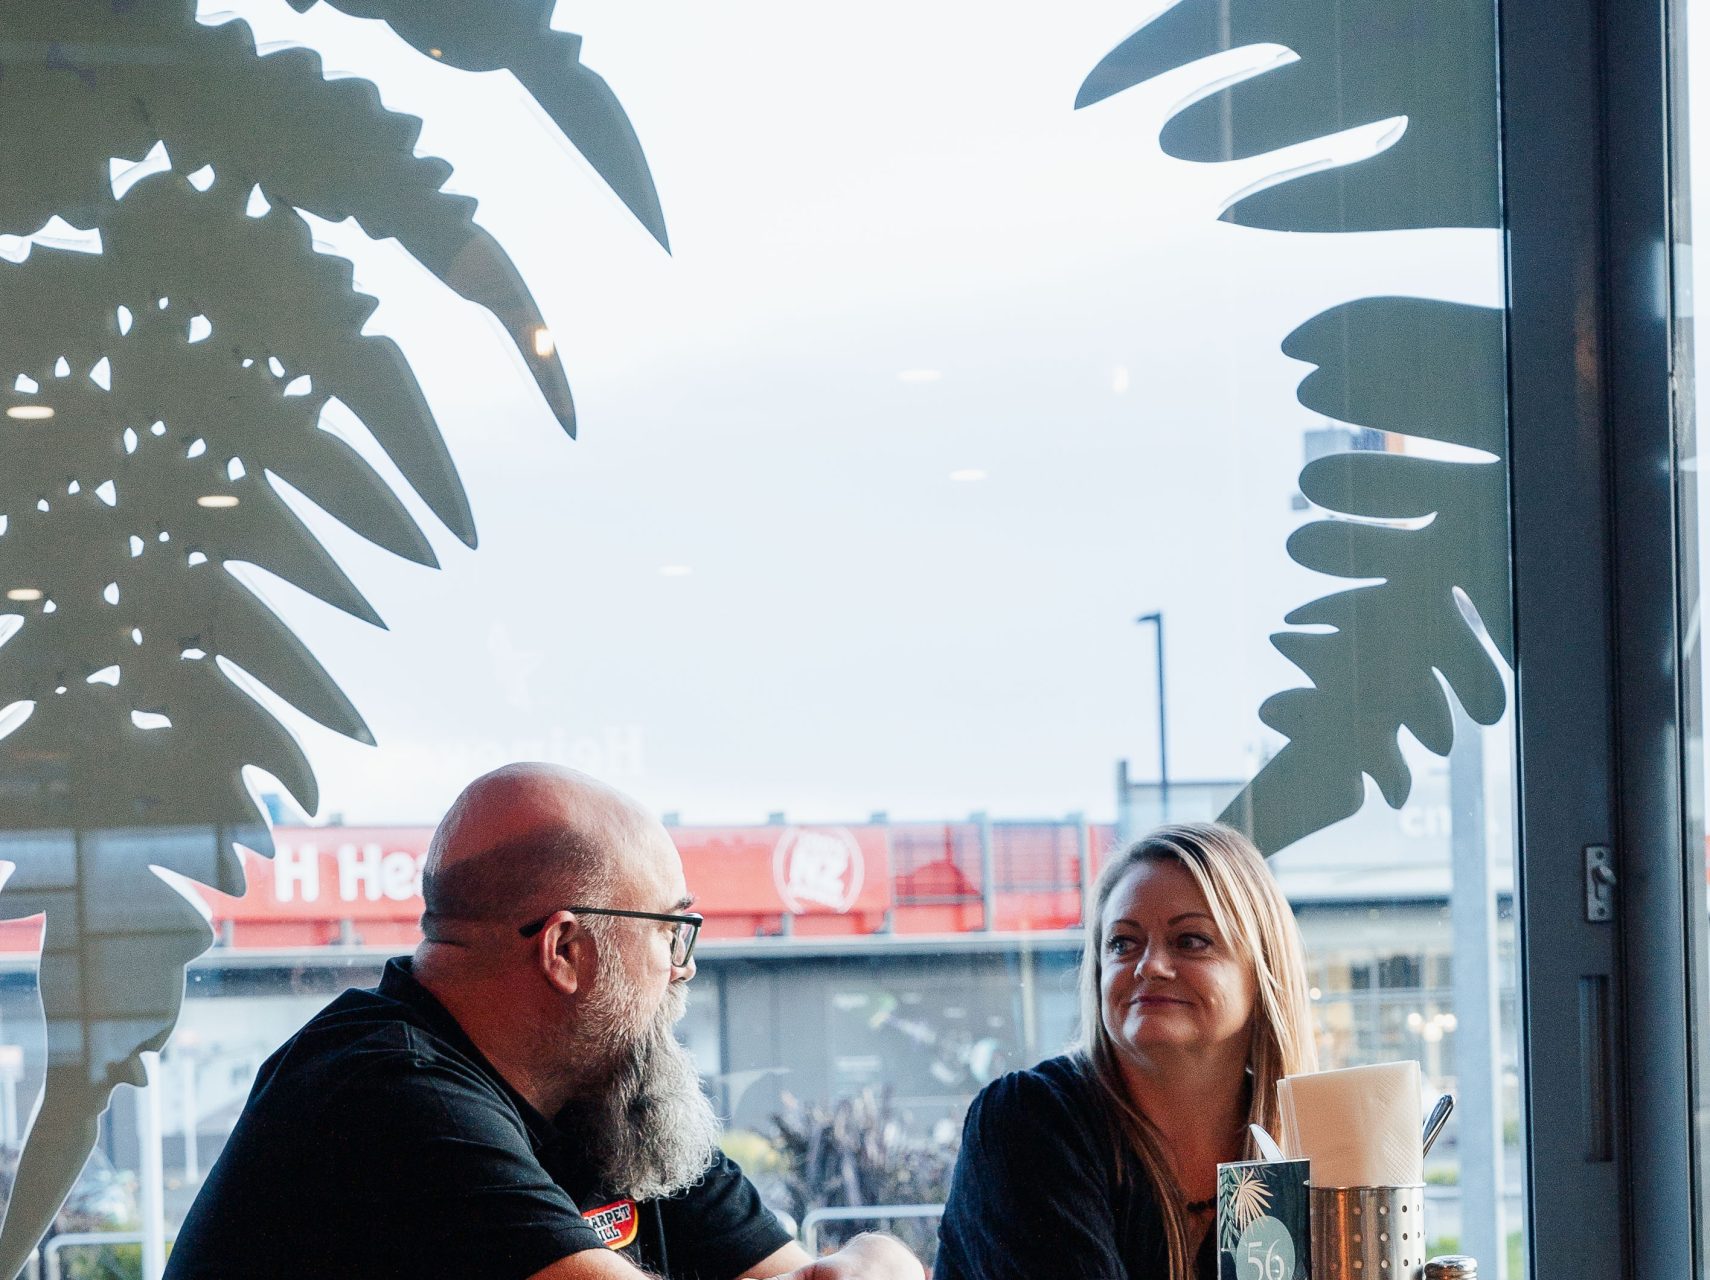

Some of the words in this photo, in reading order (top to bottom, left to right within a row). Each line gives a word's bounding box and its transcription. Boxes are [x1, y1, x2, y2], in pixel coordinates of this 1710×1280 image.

[338, 843, 425, 903] He
[586, 1204, 630, 1230] ARPET
[598, 1225, 621, 1242] ILL
